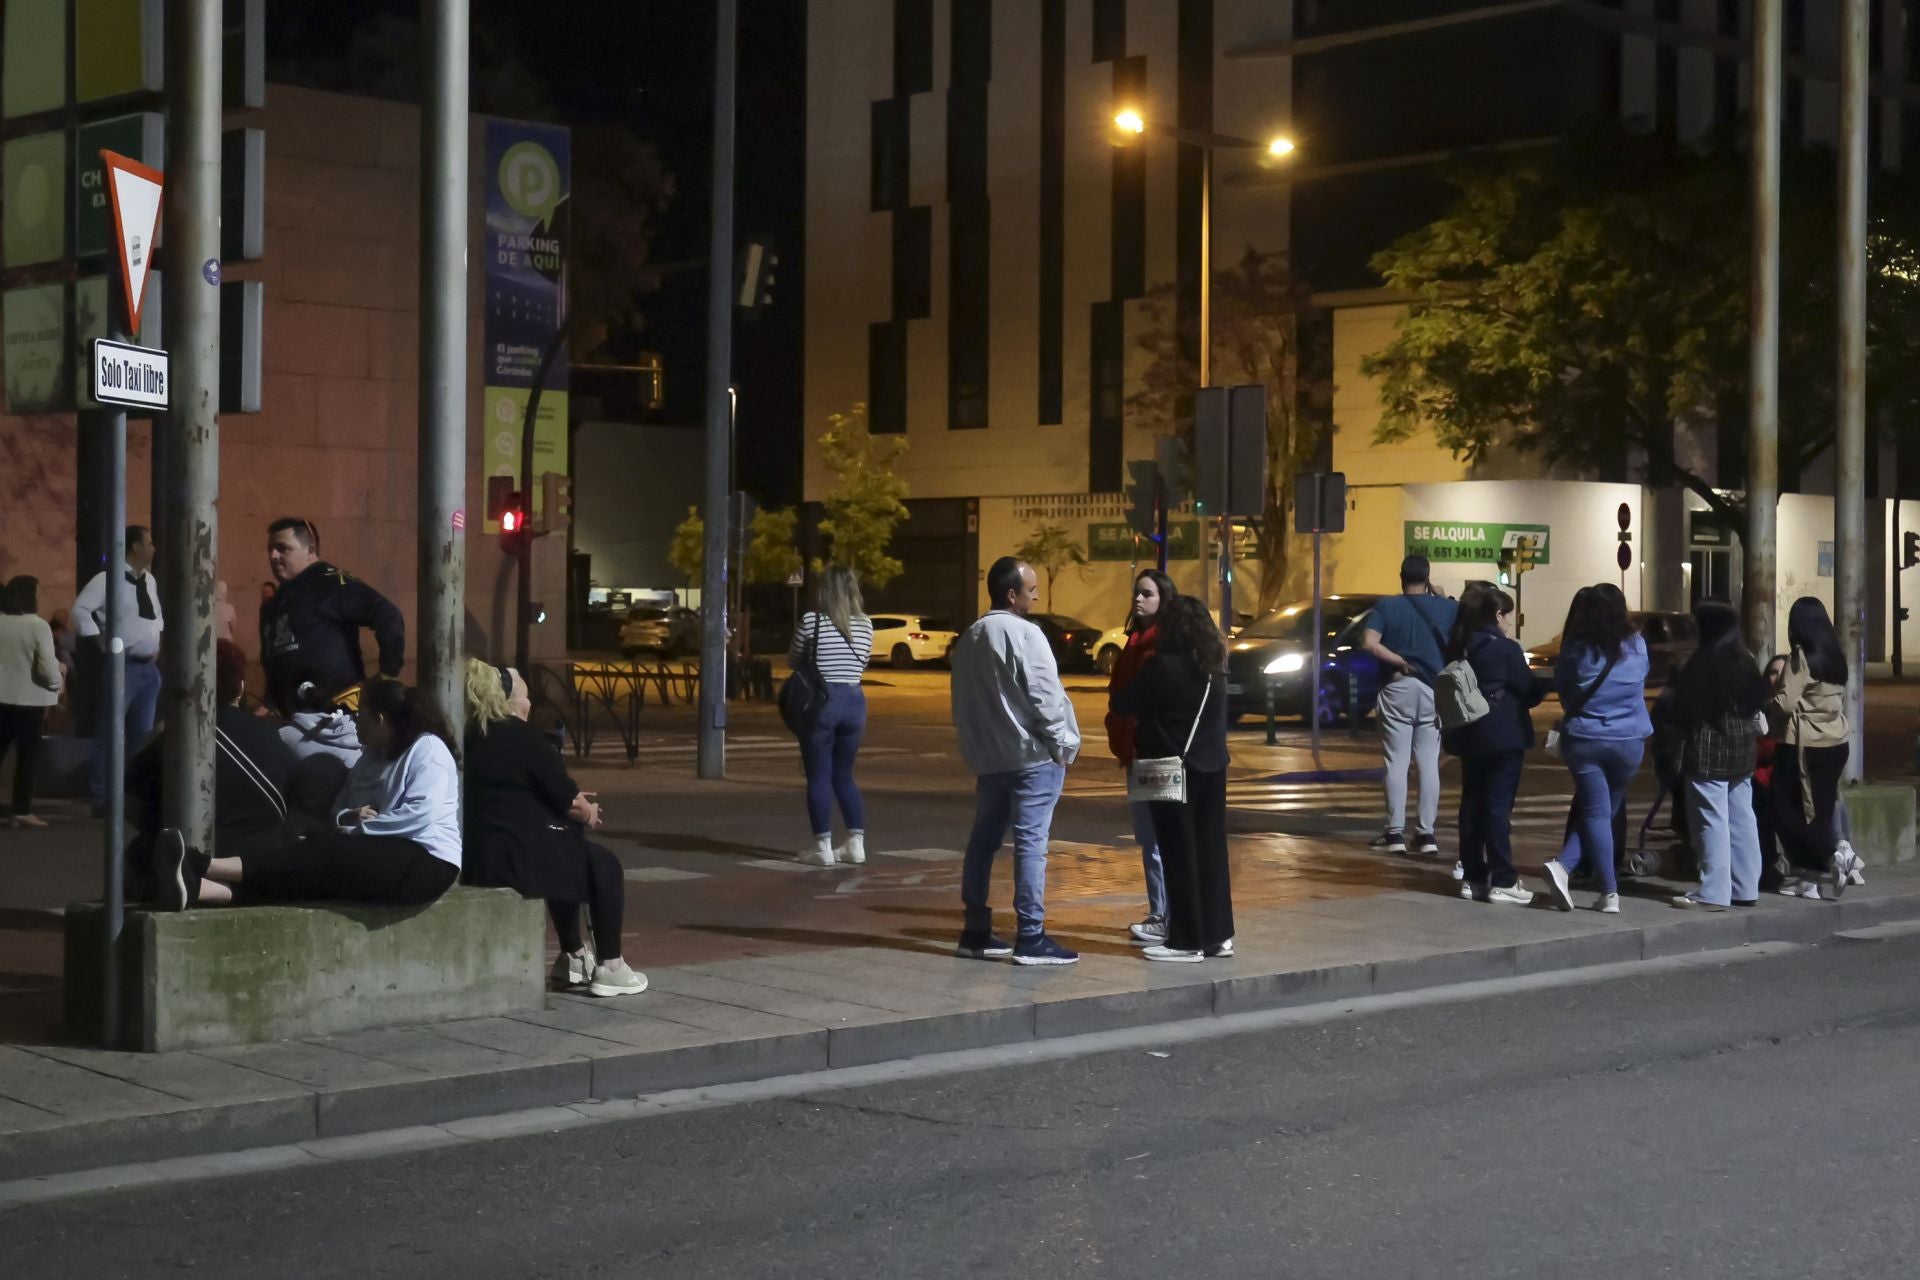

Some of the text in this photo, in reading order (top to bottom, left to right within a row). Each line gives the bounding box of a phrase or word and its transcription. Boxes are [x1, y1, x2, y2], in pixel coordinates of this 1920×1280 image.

[498, 234, 560, 255] PARKING
[497, 250, 518, 266] DE
[101, 355, 164, 395] Solo Taxi libre
[1098, 527, 1117, 541] SE
[1414, 526, 1486, 542] SE ALQUILA
[1434, 546, 1452, 559] 651
[1455, 546, 1472, 559] 341
[1474, 547, 1494, 560] 923
